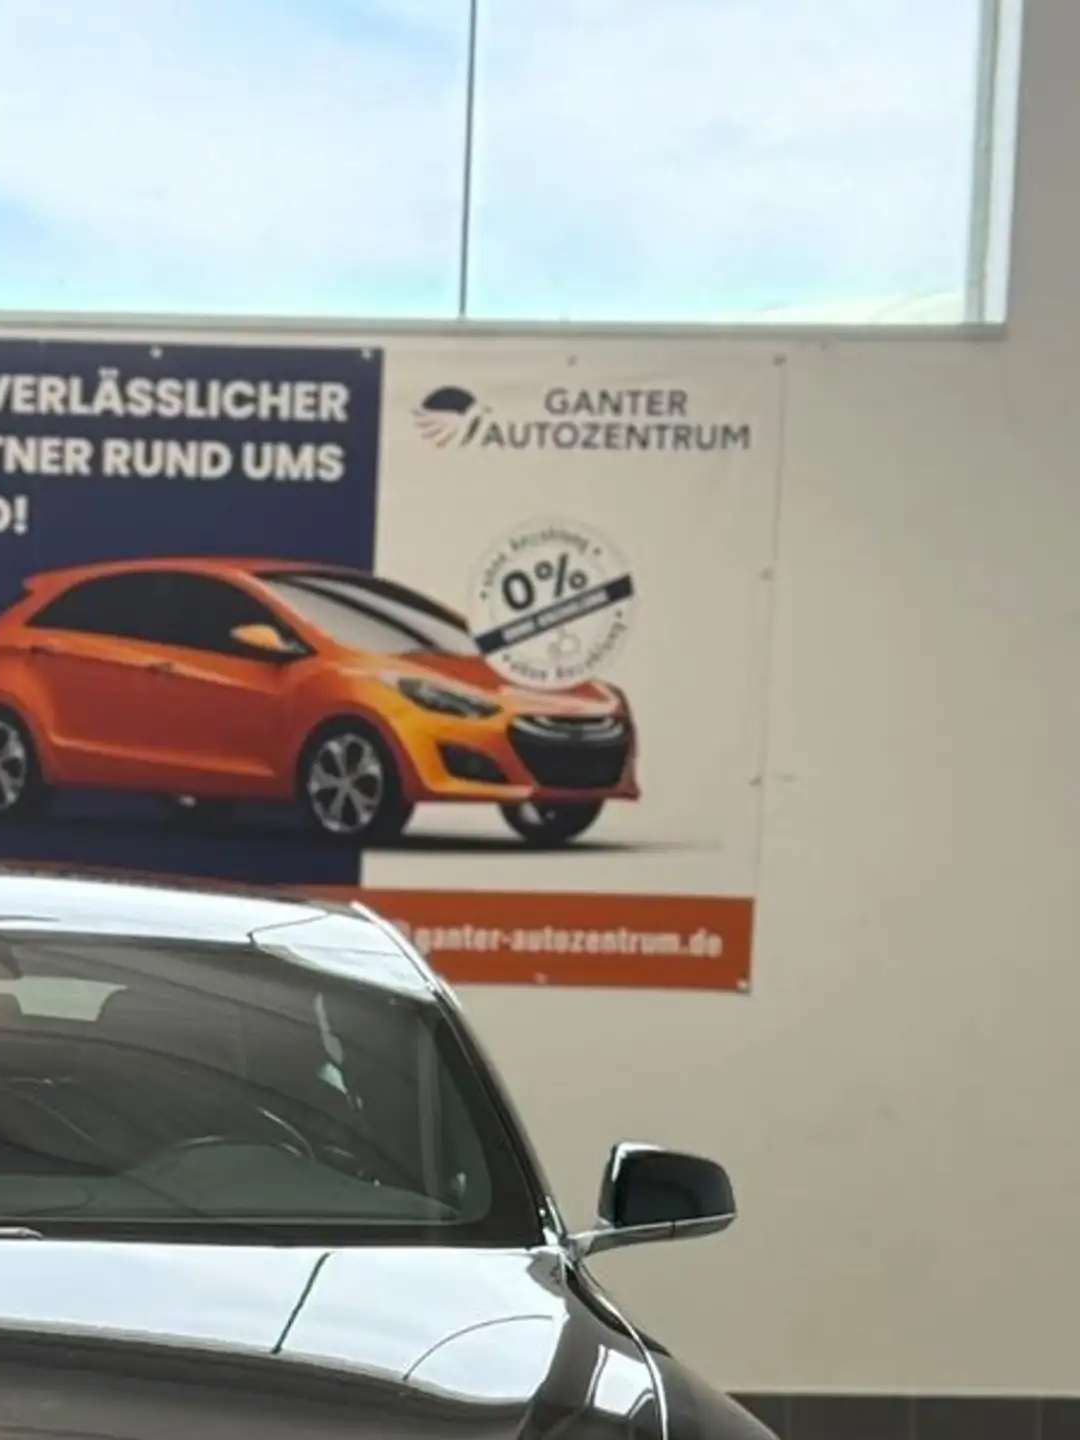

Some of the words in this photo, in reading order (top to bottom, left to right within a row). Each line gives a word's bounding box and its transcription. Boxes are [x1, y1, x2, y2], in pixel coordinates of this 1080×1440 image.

[544, 388, 688, 418] GANTER
[481, 421, 751, 451] AUTOZENTRUM
[101, 438, 233, 479] RUND
[242, 443, 346, 483] UMS
[501, 552, 589, 612] 0%
